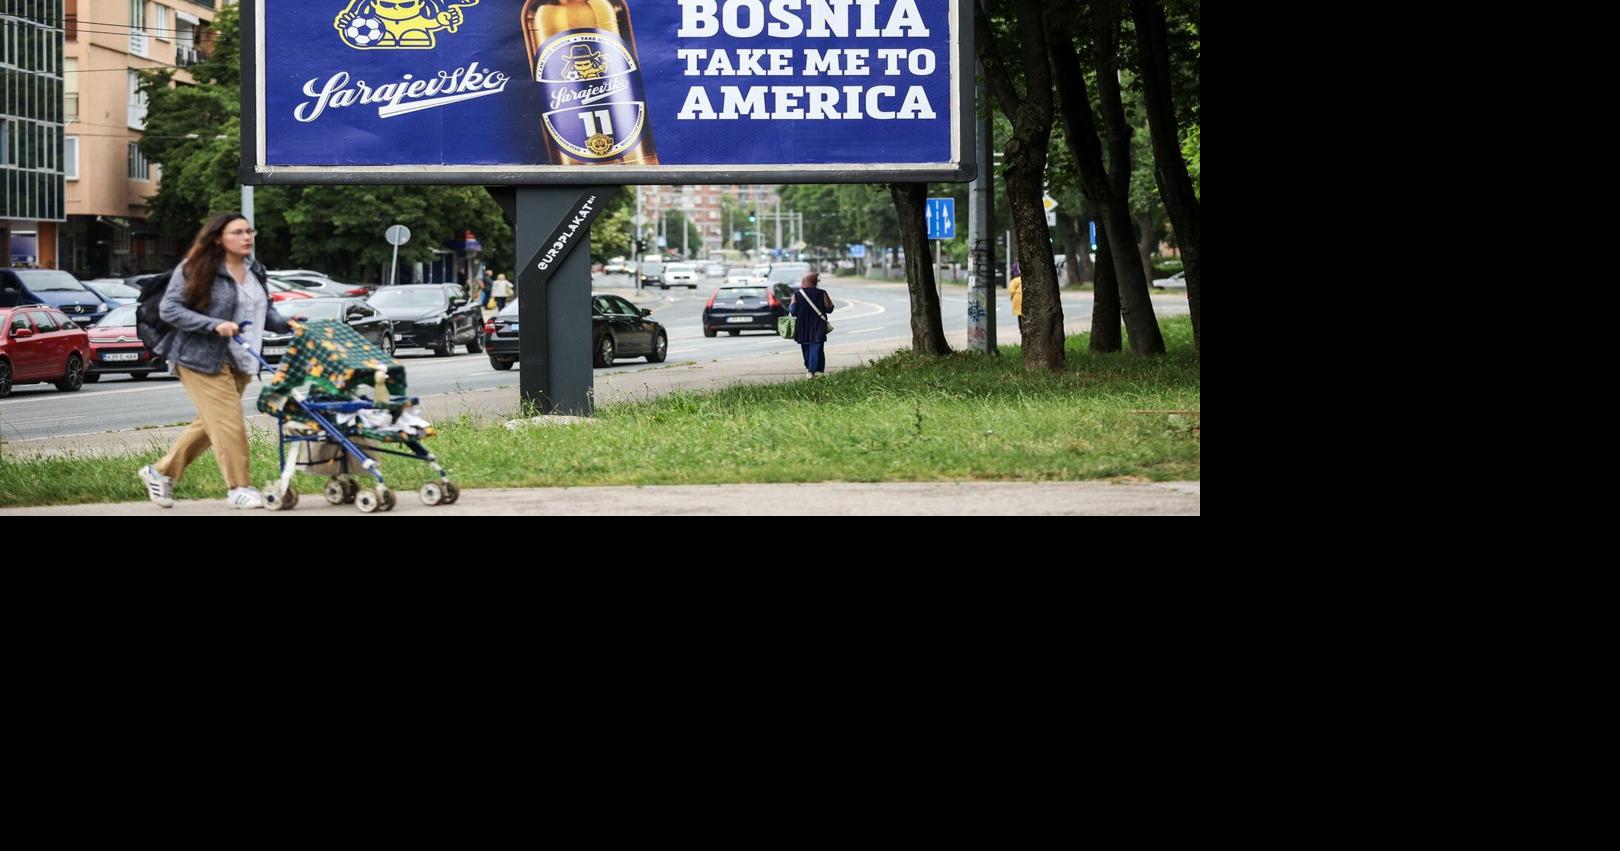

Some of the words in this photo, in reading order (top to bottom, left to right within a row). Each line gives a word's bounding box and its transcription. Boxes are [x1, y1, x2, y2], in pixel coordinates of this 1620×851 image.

[677, 0, 930, 38] BOSNIA
[677, 48, 794, 76] TAKE
[802, 48, 870, 76] ME
[877, 48, 936, 76] TO
[293, 61, 511, 122] Sarajevsko
[550, 77, 629, 110] Sarajevsko
[677, 85, 937, 120] AMERICA
[578, 109, 613, 137] 11
